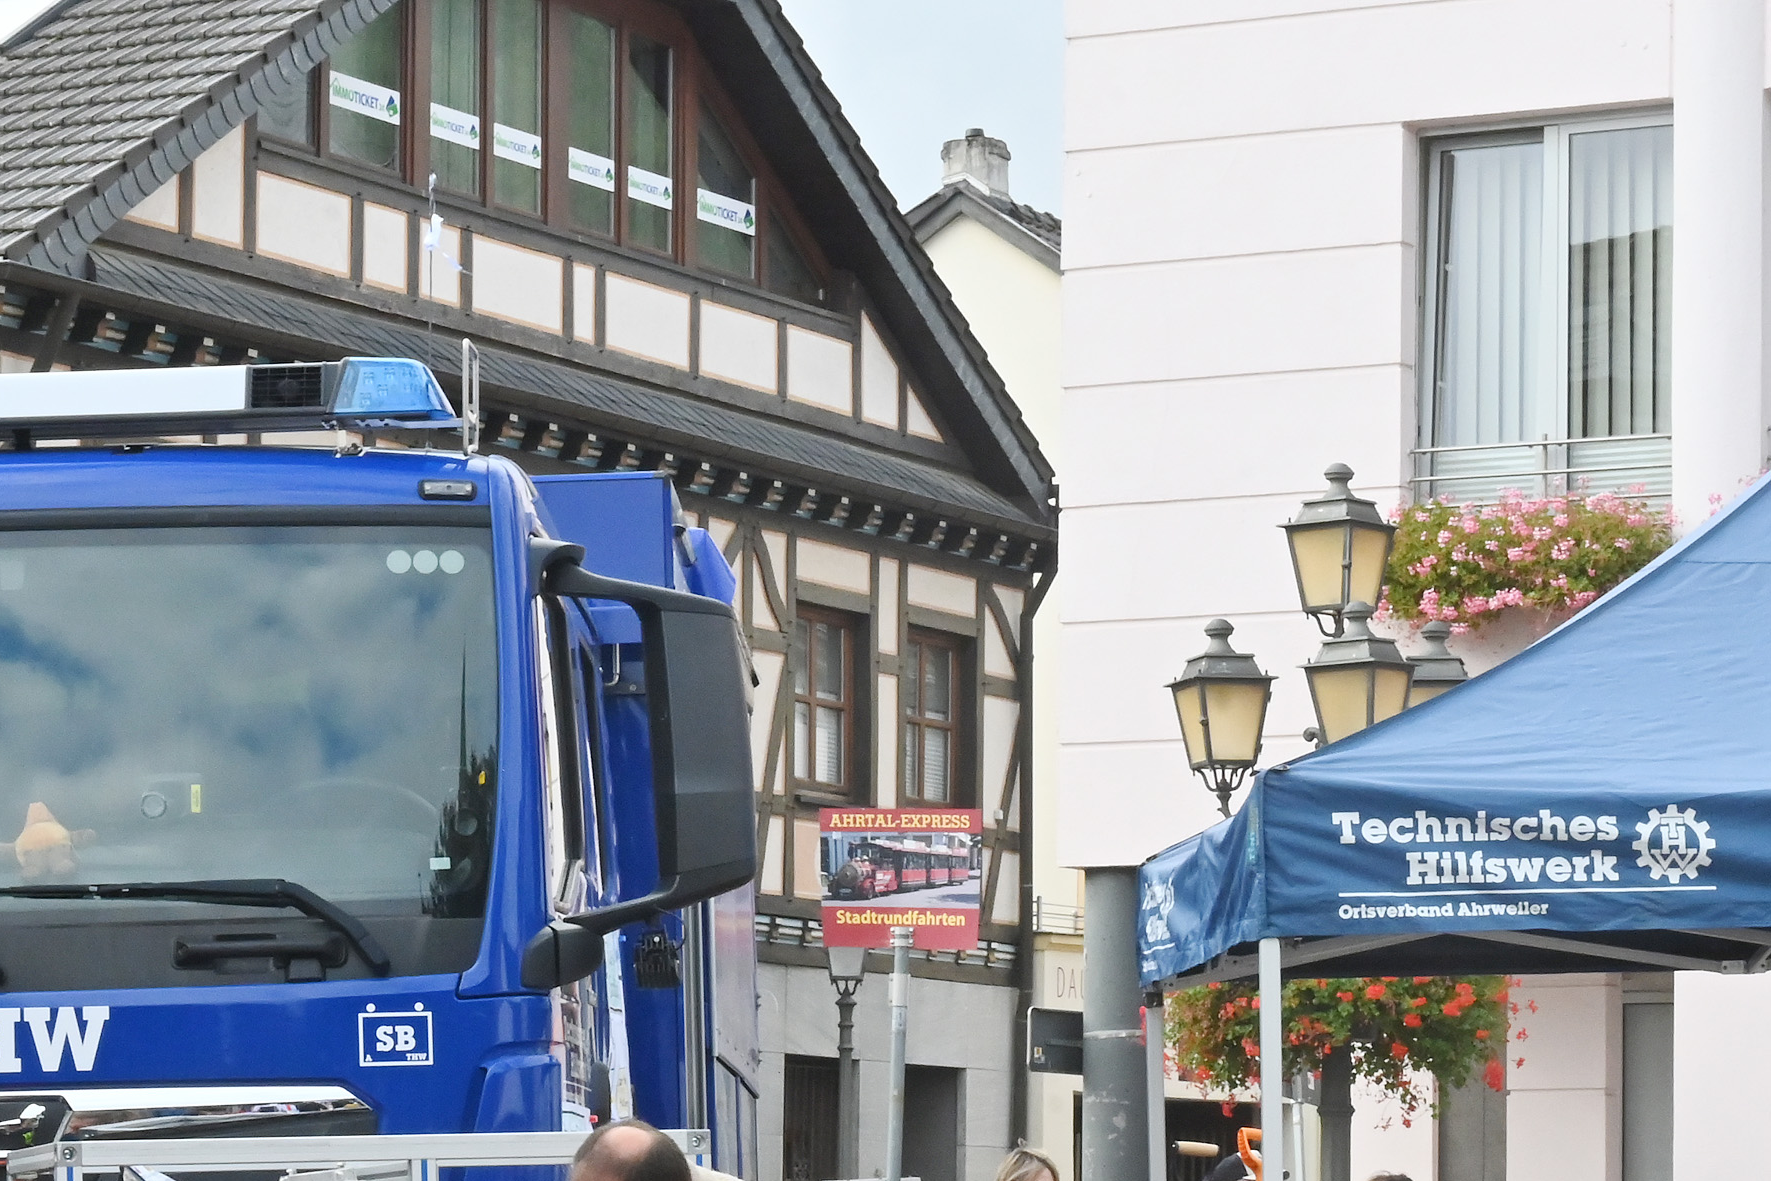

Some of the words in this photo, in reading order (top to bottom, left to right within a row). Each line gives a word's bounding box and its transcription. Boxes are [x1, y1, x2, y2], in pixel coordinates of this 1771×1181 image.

[829, 812, 971, 829] AHRTAL-EXPRESS
[1331, 809, 1619, 844] Technisches
[1405, 849, 1620, 885] Hilfswerk
[835, 909, 966, 926] Stadtrundfahrten
[1338, 902, 1454, 920] Ortsverband
[1457, 901, 1549, 917] Ahrweiler
[375, 1025, 417, 1052] SB
[364, 1054, 373, 1062] A
[405, 1052, 428, 1061] THW
